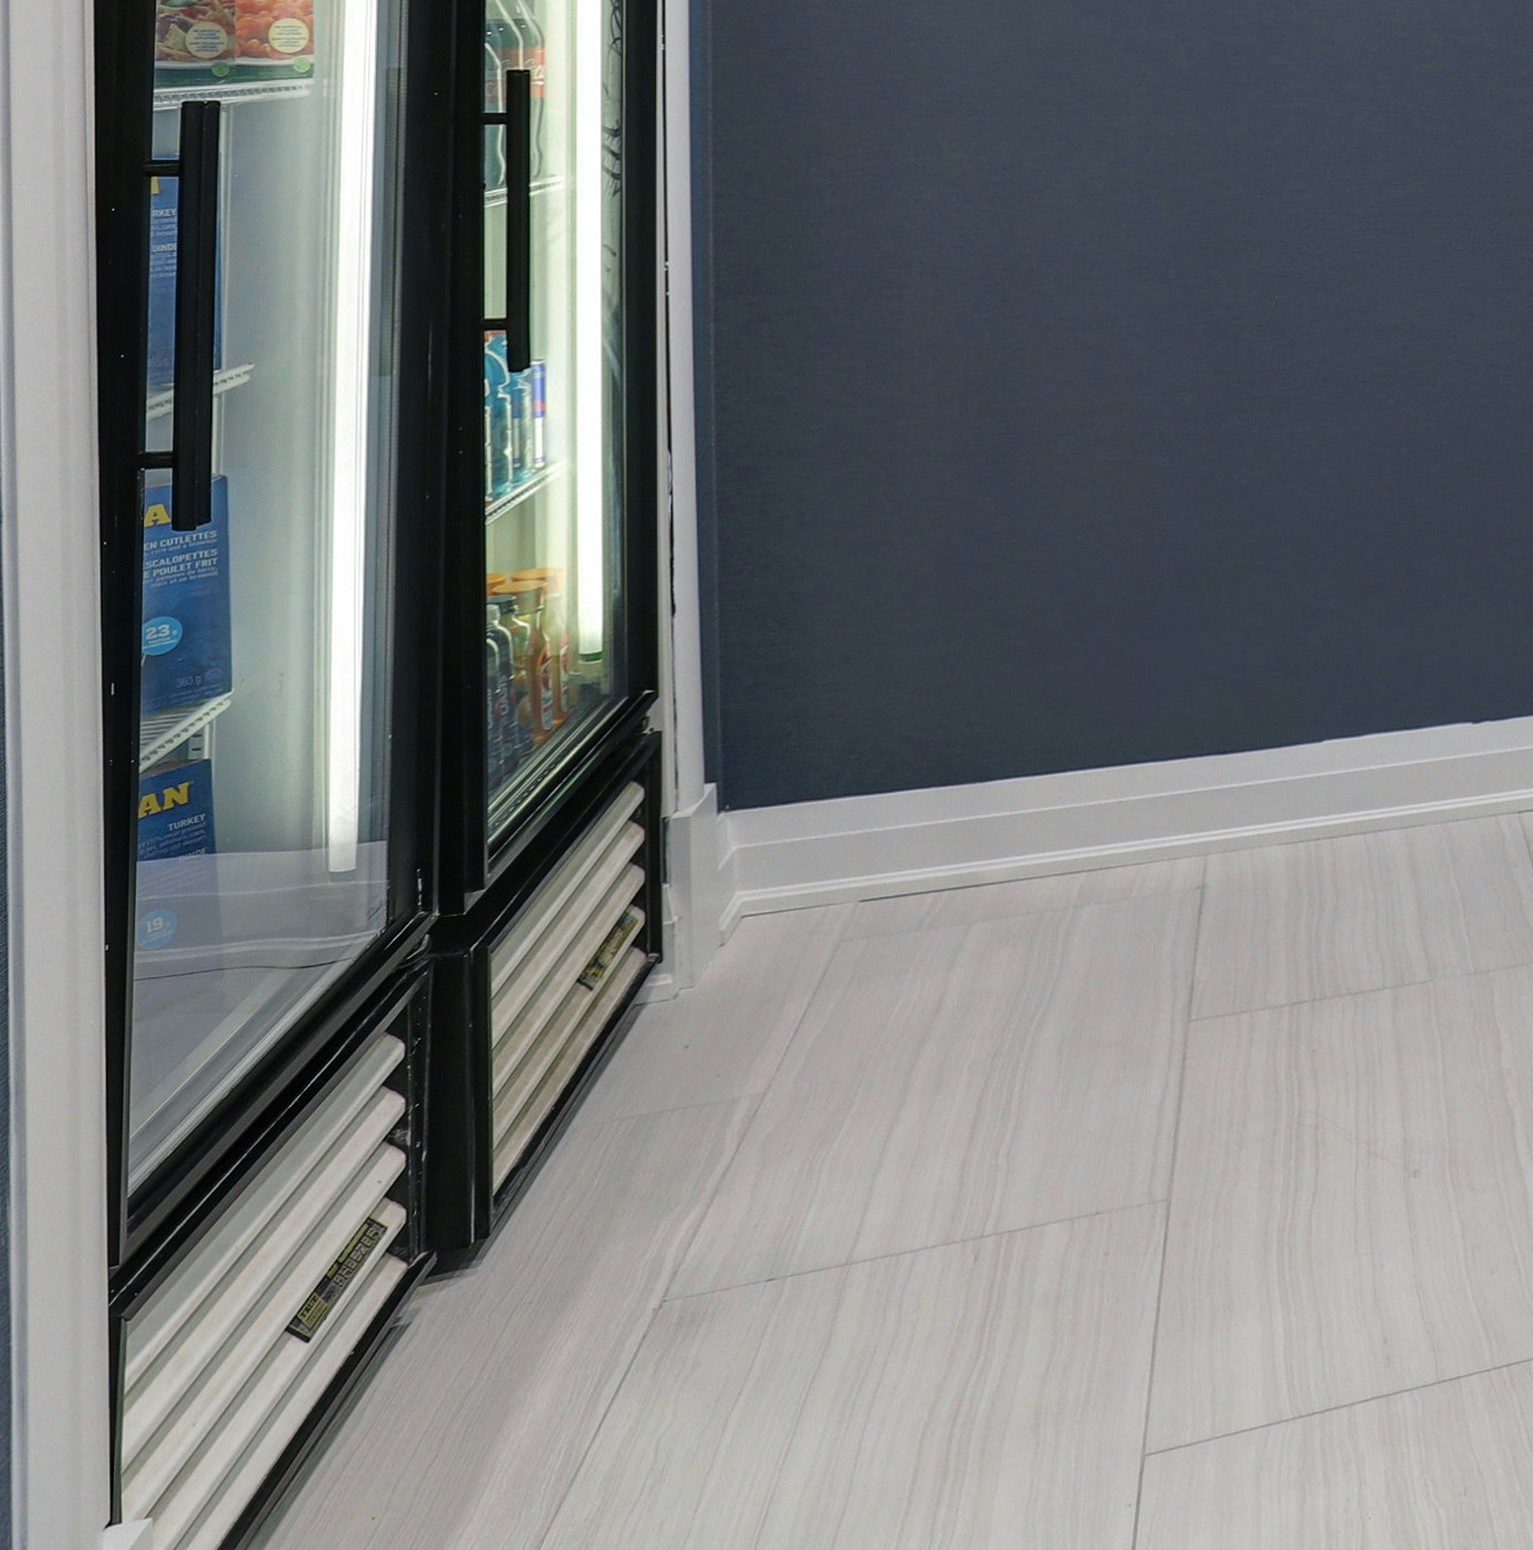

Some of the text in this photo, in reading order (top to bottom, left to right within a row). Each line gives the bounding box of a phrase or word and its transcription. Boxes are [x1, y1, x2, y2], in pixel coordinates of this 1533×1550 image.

[153, 558, 219, 577] POULET FRIT
[145, 625, 170, 640] 23
[168, 813, 207, 832] TURKEY
